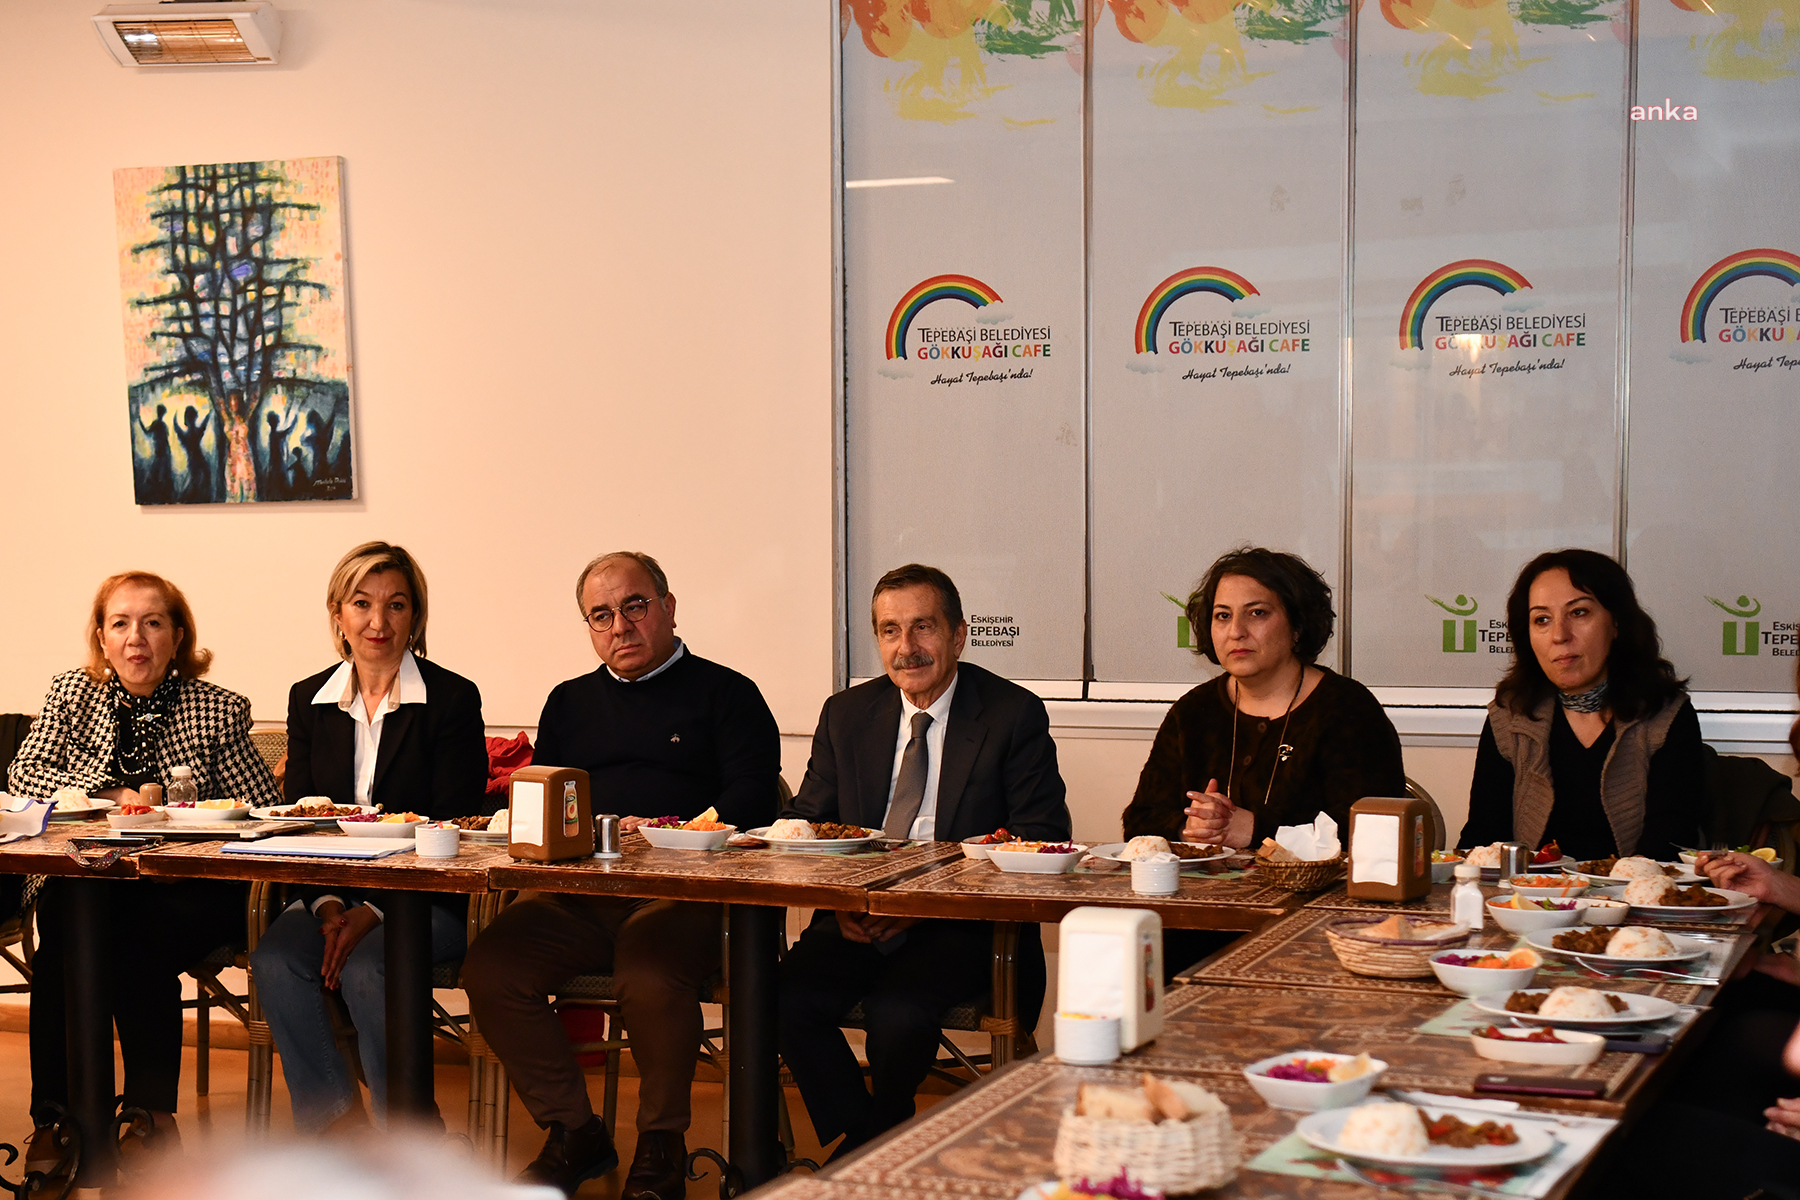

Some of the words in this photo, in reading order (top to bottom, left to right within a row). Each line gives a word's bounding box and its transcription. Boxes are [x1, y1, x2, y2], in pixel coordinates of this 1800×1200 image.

[1235, 320, 1310, 335] BELEDİYESİ
[1506, 313, 1586, 330] BELEDİYESİ
[980, 326, 1051, 341] BELEDİYESİ
[1542, 332, 1586, 347] CAFE
[1718, 325, 1800, 344] GÖKKUŞ
[917, 342, 1008, 362] GÖKKUŞAĞI
[1012, 344, 1051, 358] CAFE
[1169, 337, 1264, 356] GÖKKUŞAĞI
[1269, 338, 1310, 353] CAFE
[1449, 364, 1486, 378] Hayat
[1733, 356, 1774, 372] Hayat
[930, 373, 964, 387] Hayat
[1182, 367, 1217, 382] Hayat
[971, 614, 1013, 624] ESKİŞEHİR
[967, 624, 1020, 638] EPEBAŞI
[971, 638, 1014, 647] BELEDİYESİ
